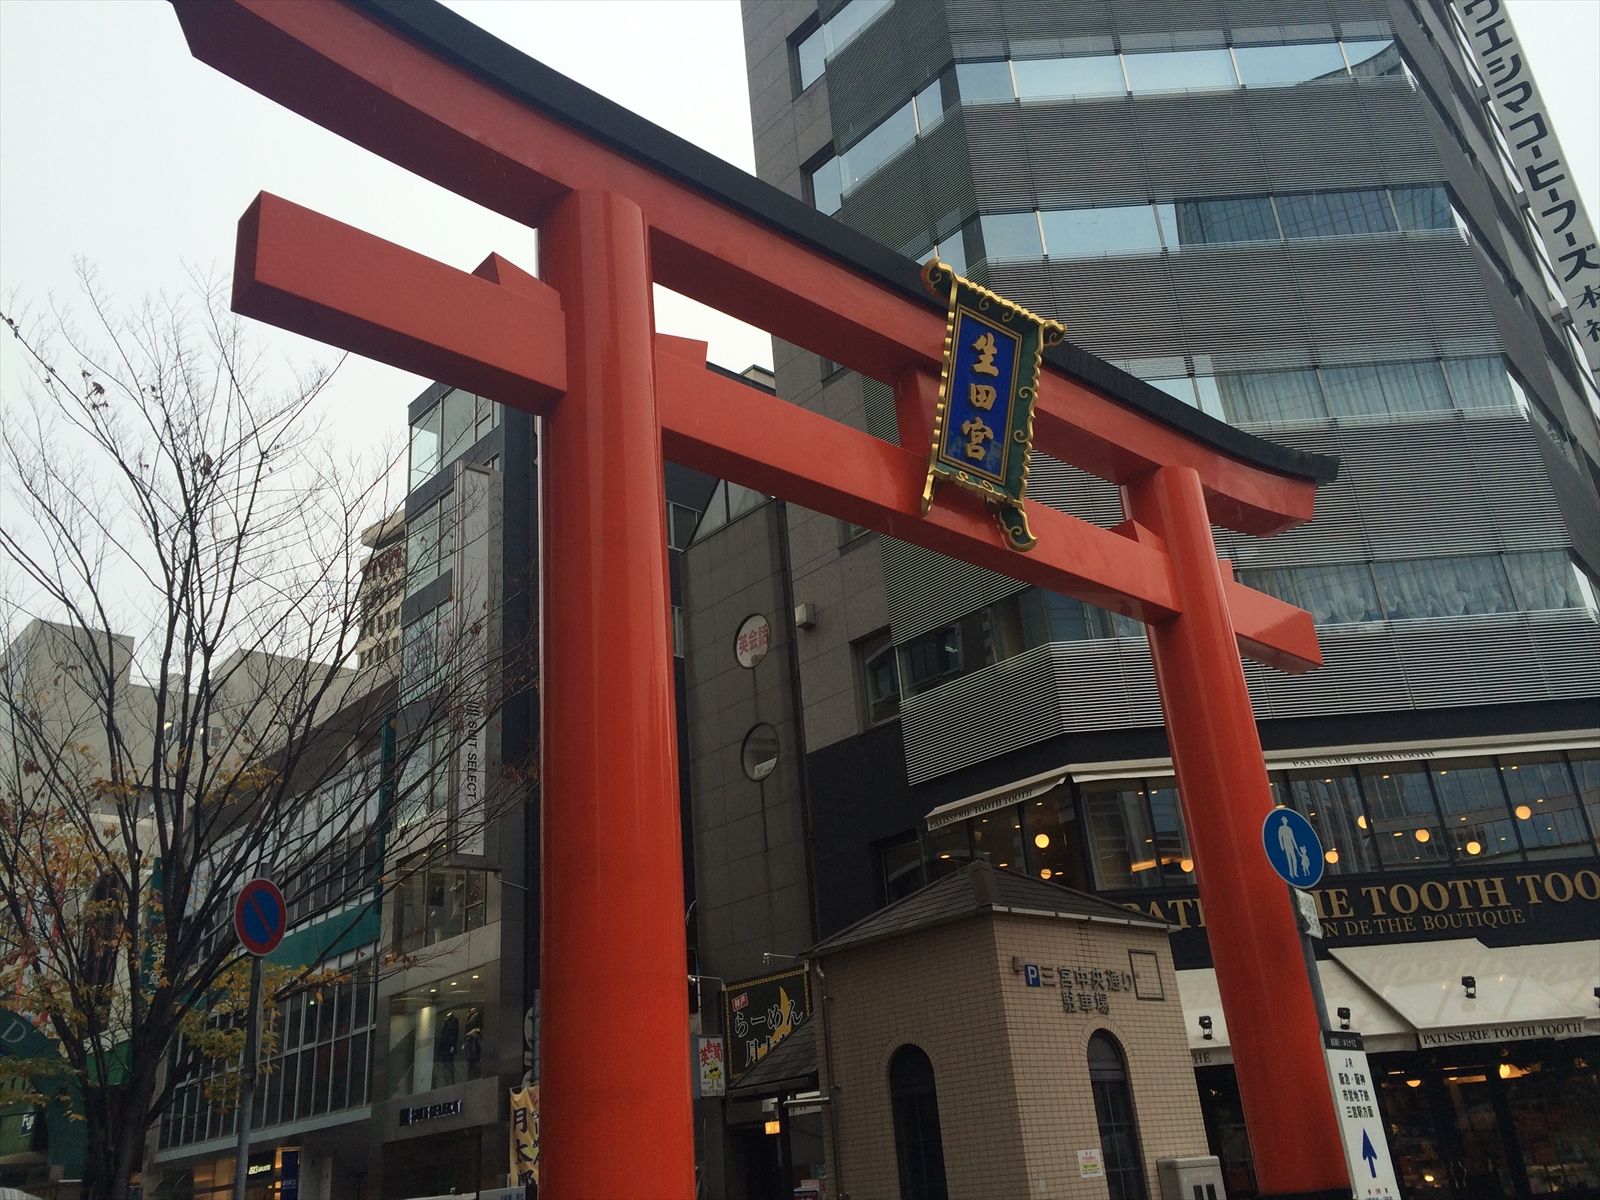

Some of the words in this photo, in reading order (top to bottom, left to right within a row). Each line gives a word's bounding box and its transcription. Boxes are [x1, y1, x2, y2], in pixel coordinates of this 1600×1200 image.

[959, 331, 1000, 462] 生田宮
[466, 752, 477, 800] SELECT
[1360, 877, 1512, 917] TOOTH
[1344, 919, 1373, 937] DE
[1421, 908, 1526, 931] BOUTIQUE
[1041, 965, 1134, 992] 三宮中央通り
[735, 999, 803, 1038] らーめん
[1061, 990, 1110, 1015] 駐車場
[1422, 1029, 1491, 1046] PATISSERIE
[1492, 1025, 1537, 1039] TOOTH
[1537, 1022, 1584, 1036] TOOTH
